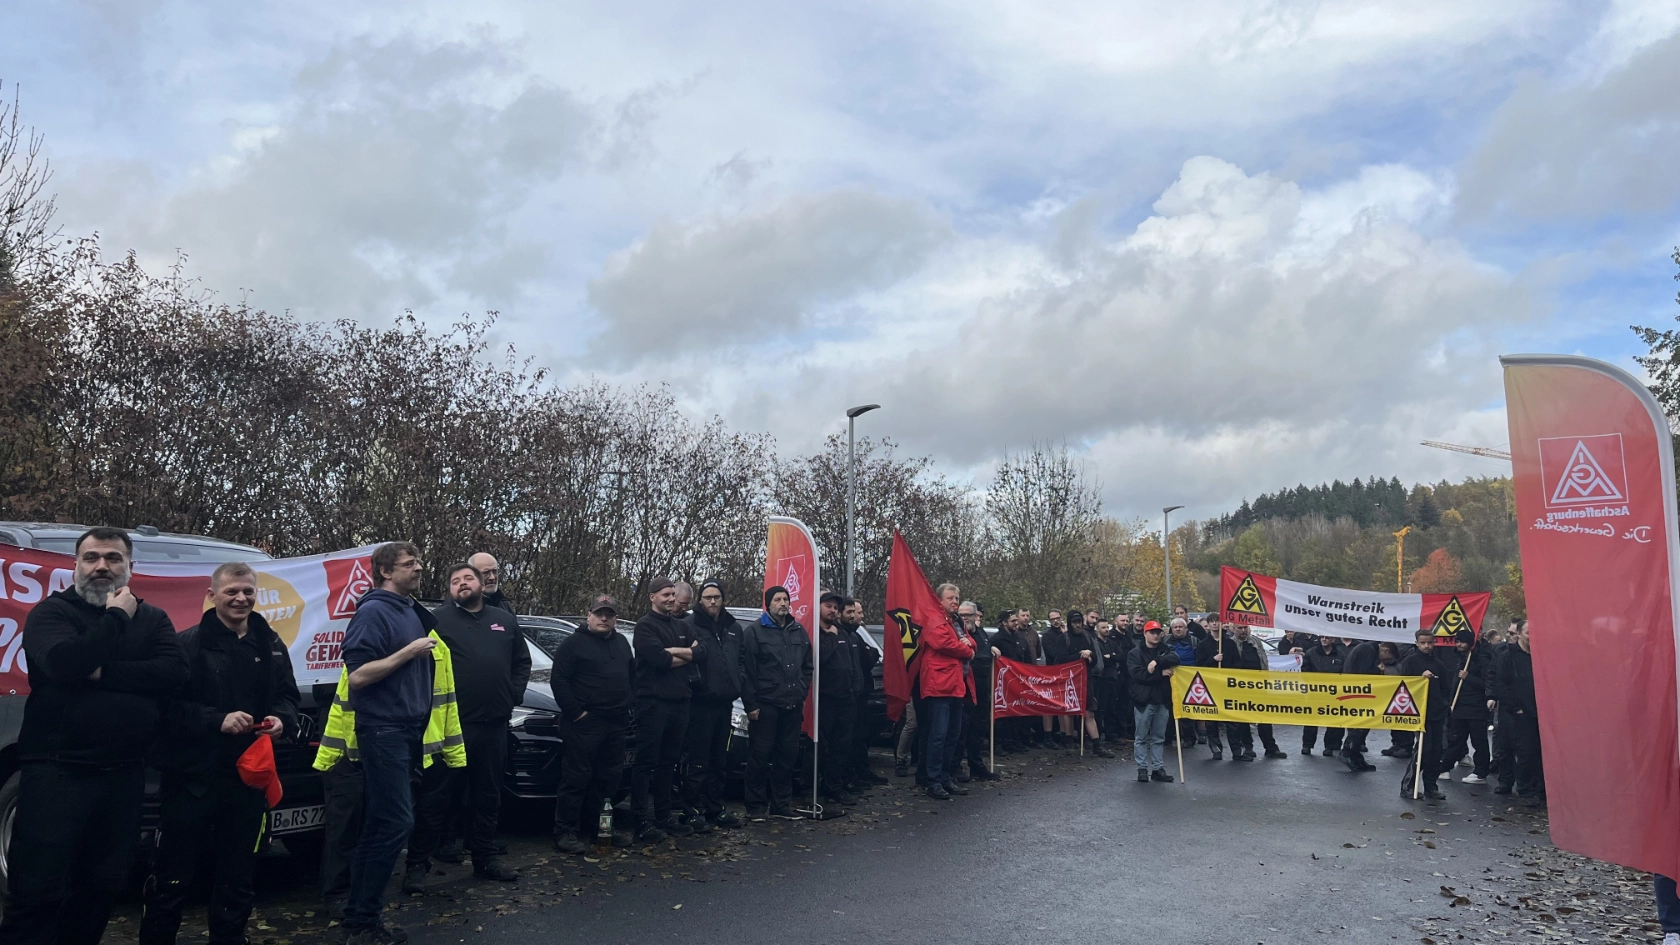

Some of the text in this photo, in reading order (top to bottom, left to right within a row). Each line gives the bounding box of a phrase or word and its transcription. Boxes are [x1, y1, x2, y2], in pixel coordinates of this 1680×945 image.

[1307, 594, 1385, 614] Warnstreik
[1225, 611, 1270, 626] IG Metall
[1285, 604, 1408, 629] unser gutes Recht
[1227, 677, 1372, 695] Beschäftigung und
[1183, 705, 1219, 715] IG Metall
[1223, 699, 1376, 717] Einkommen sichern
[1382, 715, 1393, 724] IG
[291, 809, 308, 826] RS
